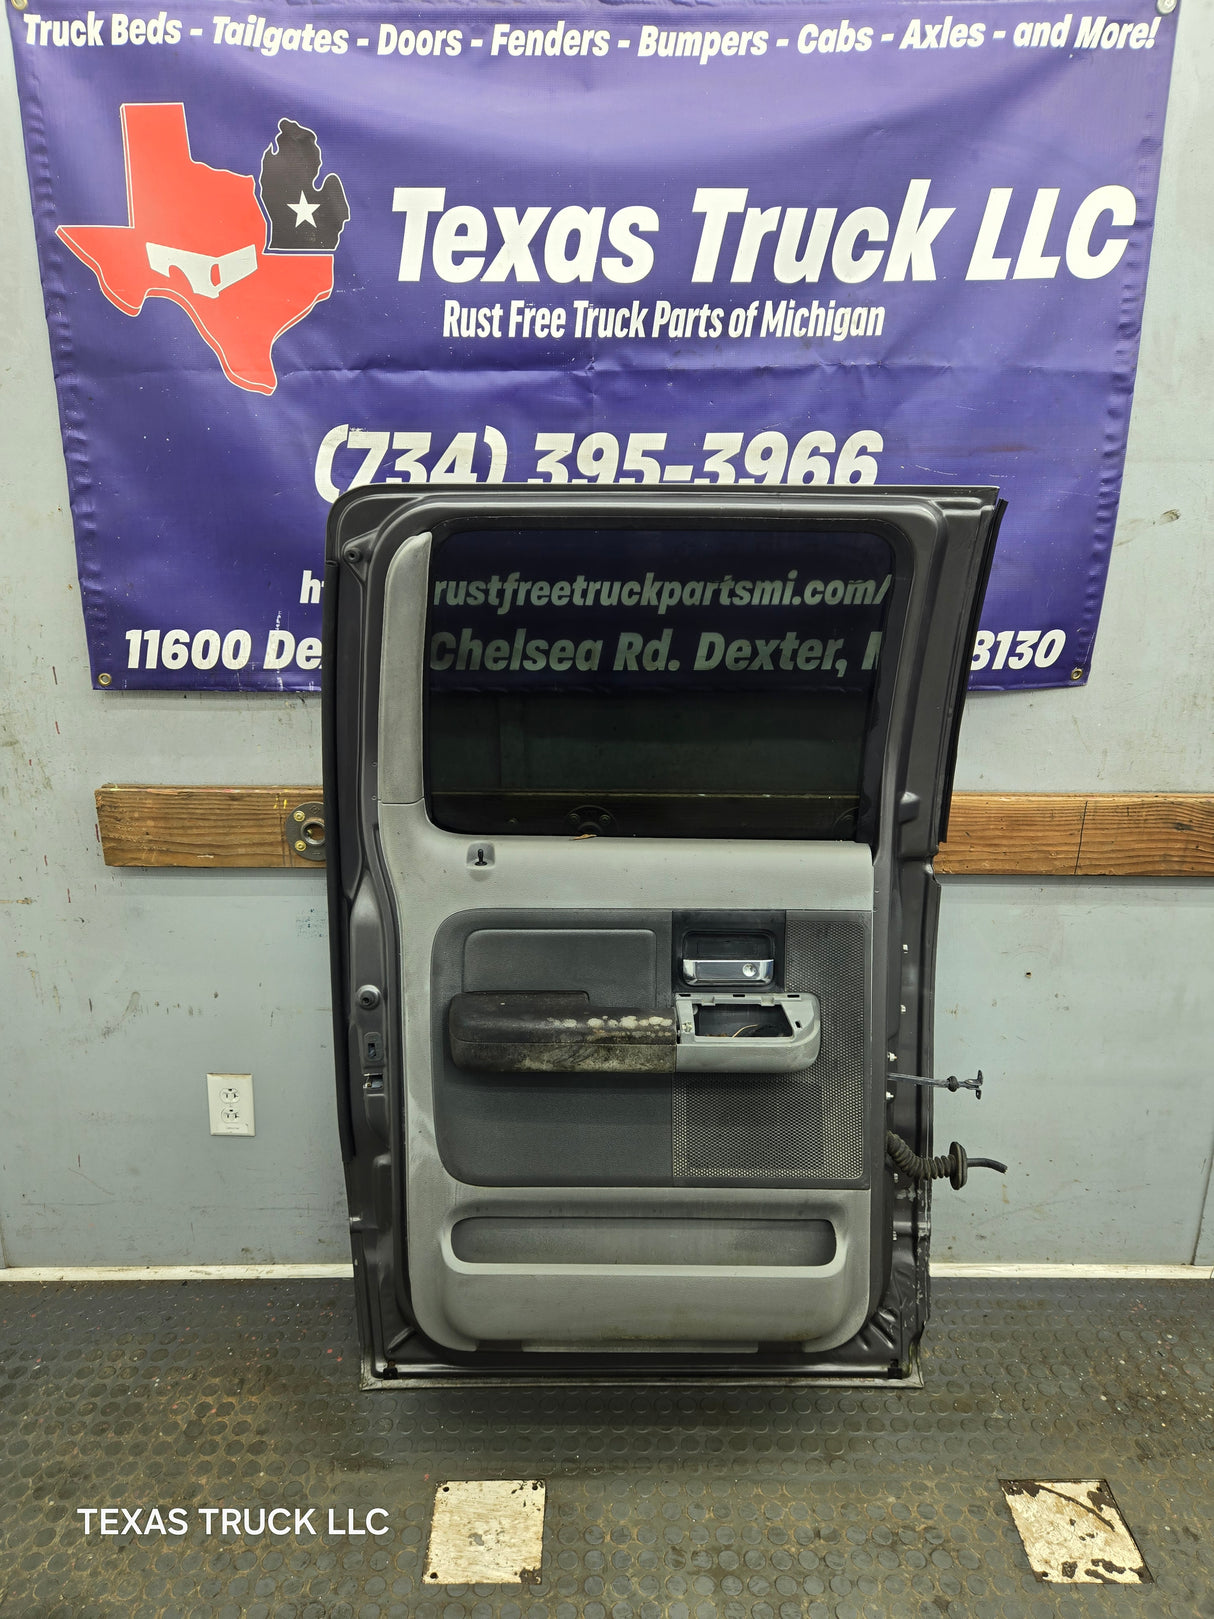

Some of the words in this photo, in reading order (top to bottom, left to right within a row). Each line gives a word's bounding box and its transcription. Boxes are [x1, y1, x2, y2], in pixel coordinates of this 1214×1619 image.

[23, 11, 105, 47] Truck
[111, 11, 183, 46] Beds
[211, 15, 350, 58] Tailgates
[376, 24, 463, 57] Doors
[490, 21, 611, 57] Fenders
[637, 25, 769, 65] Bumpers
[796, 20, 875, 55] Cabs
[897, 16, 987, 51] Axles
[1012, 14, 1074, 48] and
[1073, 16, 1163, 50] More!
[391, 187, 660, 284] Texas
[691, 178, 957, 284] Truck
[964, 184, 1137, 281] LLC
[442, 299, 504, 338] Rust
[508, 299, 567, 339] Free
[573, 300, 649, 339] Truck
[652, 300, 725, 339] Parts
[728, 300, 760, 338] of
[759, 299, 886, 342] Michigan
[315, 424, 508, 504] (734)
[527, 430, 885, 485] 395-3966
[125, 629, 252, 670] 11600
[429, 628, 604, 672] Chelsea
[612, 628, 681, 672] Rd.
[693, 631, 848, 678] Dexter,
[970, 629, 1067, 671] 8130
